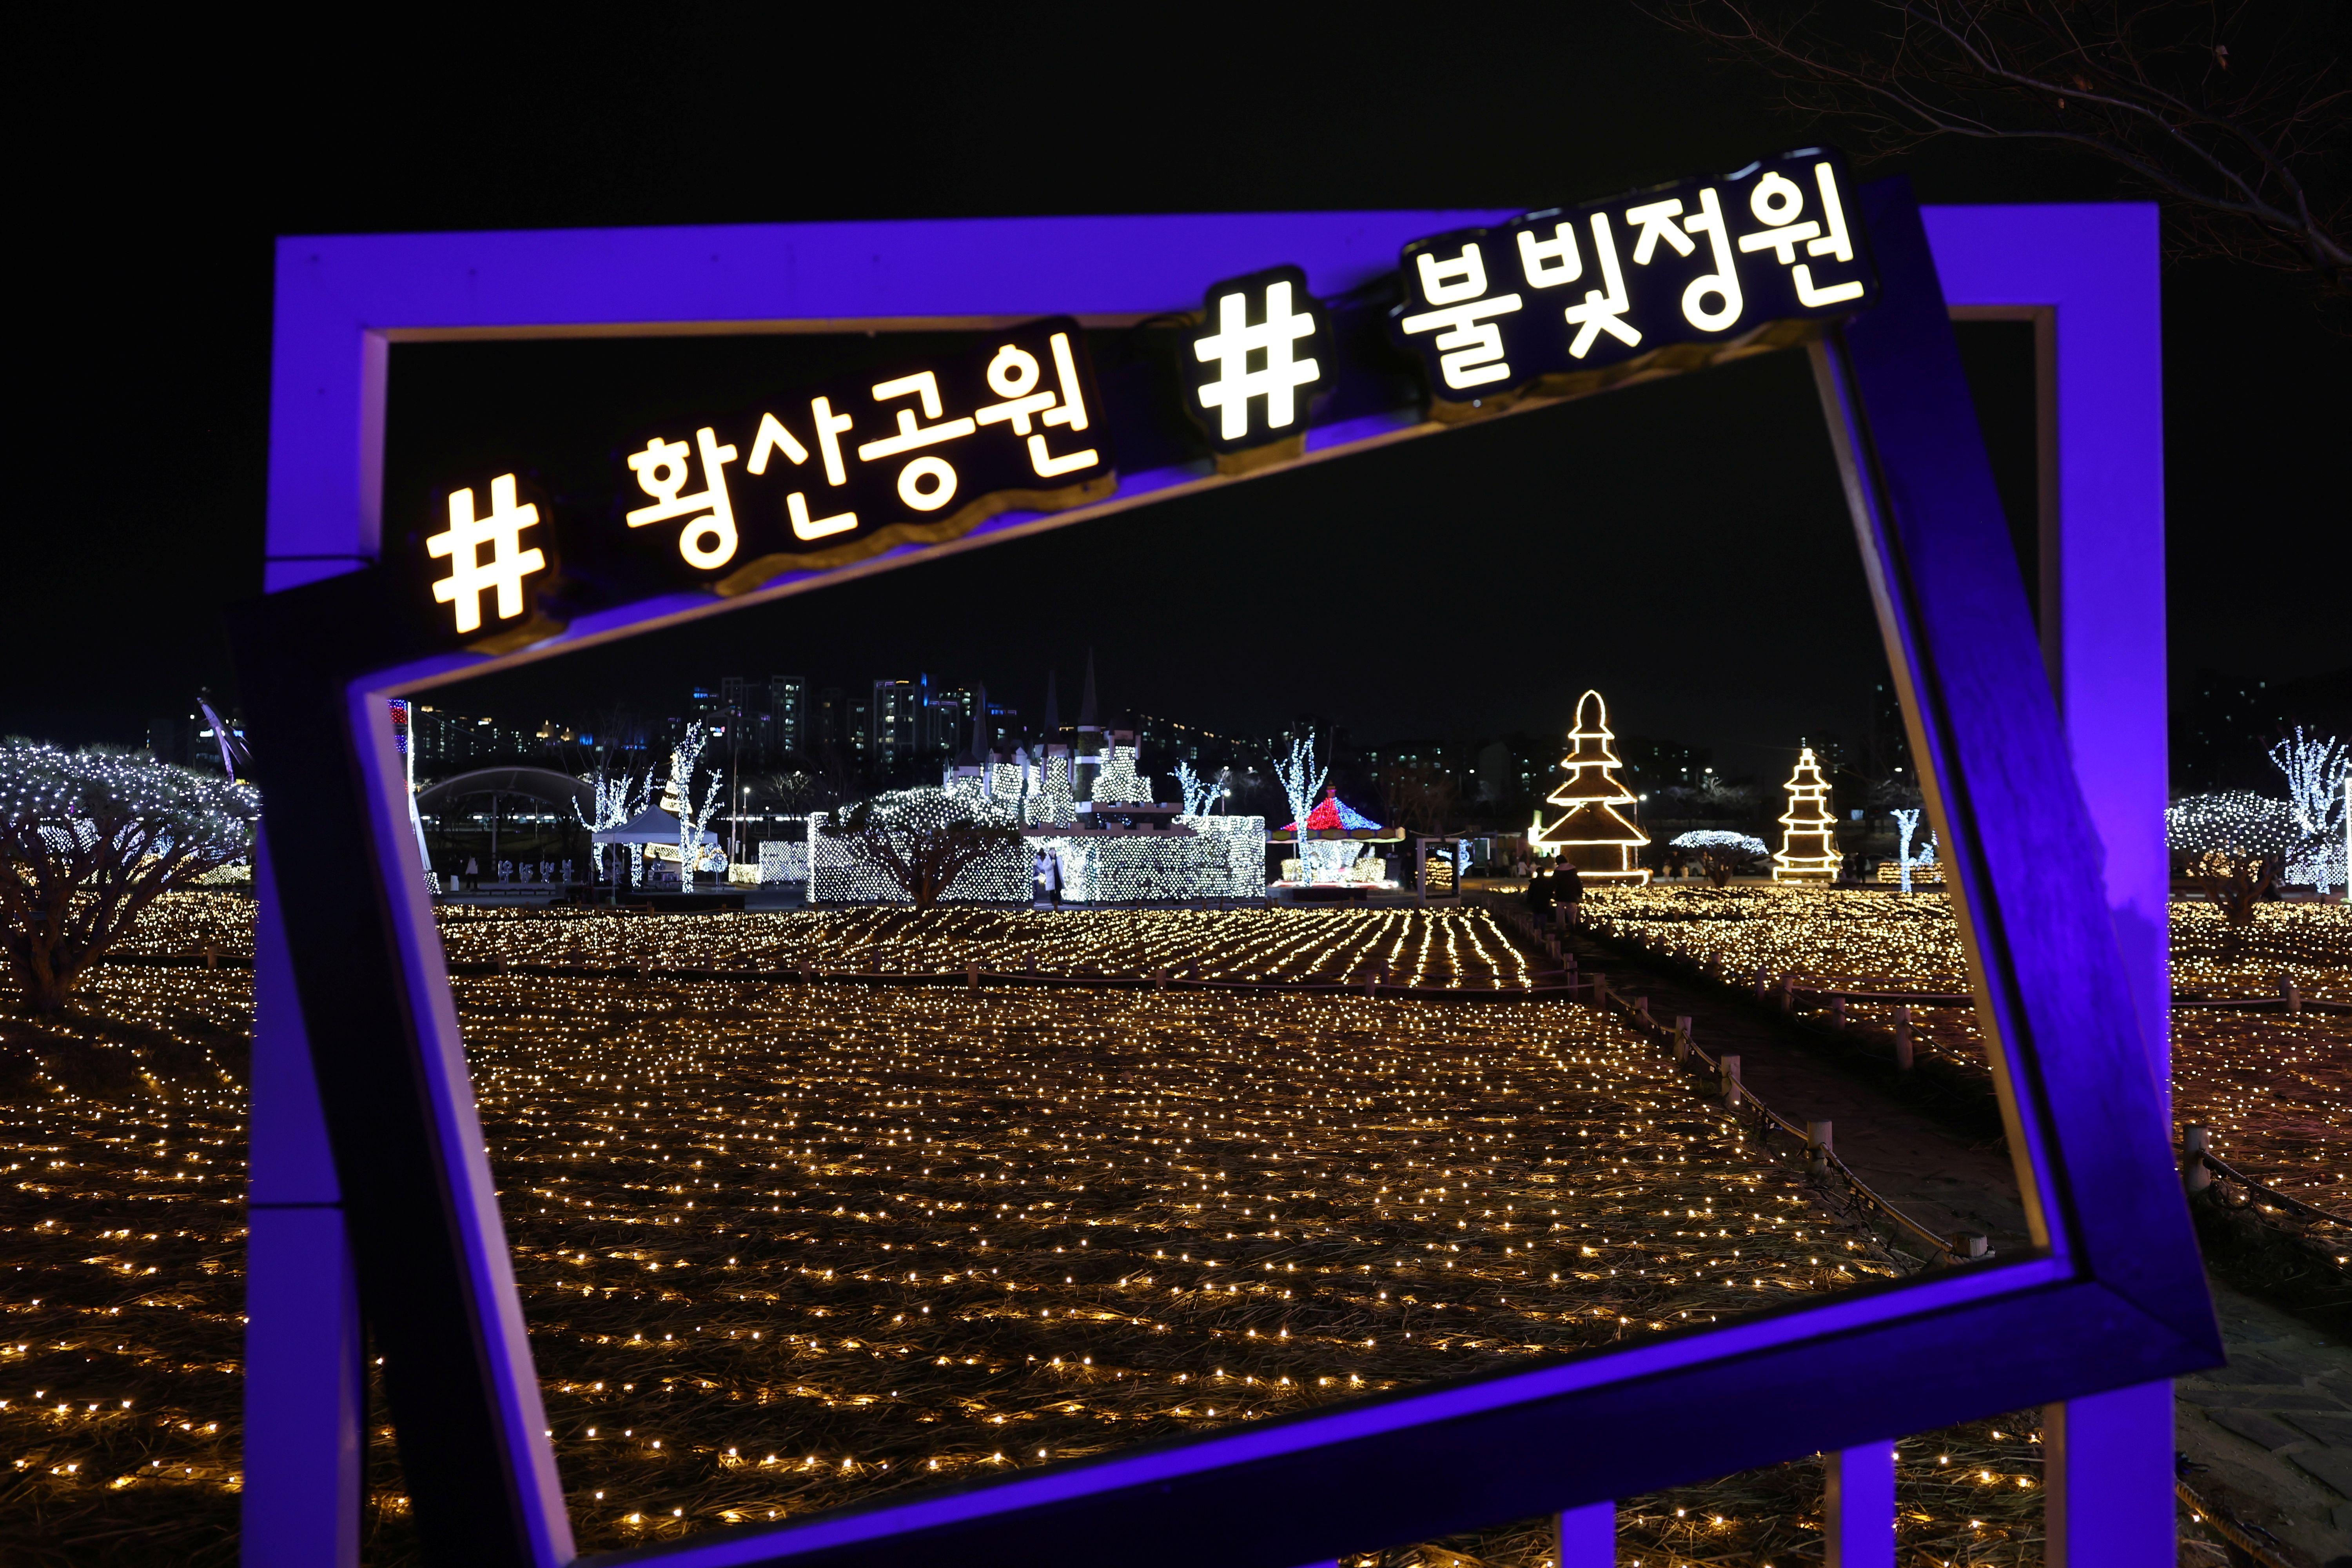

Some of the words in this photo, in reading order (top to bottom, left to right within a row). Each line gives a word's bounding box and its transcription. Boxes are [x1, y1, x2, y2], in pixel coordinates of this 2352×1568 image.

[426, 473, 546, 633] #
[626, 332, 1099, 570] 황산공원
[1193, 280, 1321, 441] #
[1401, 162, 1864, 390] 불빛정원
